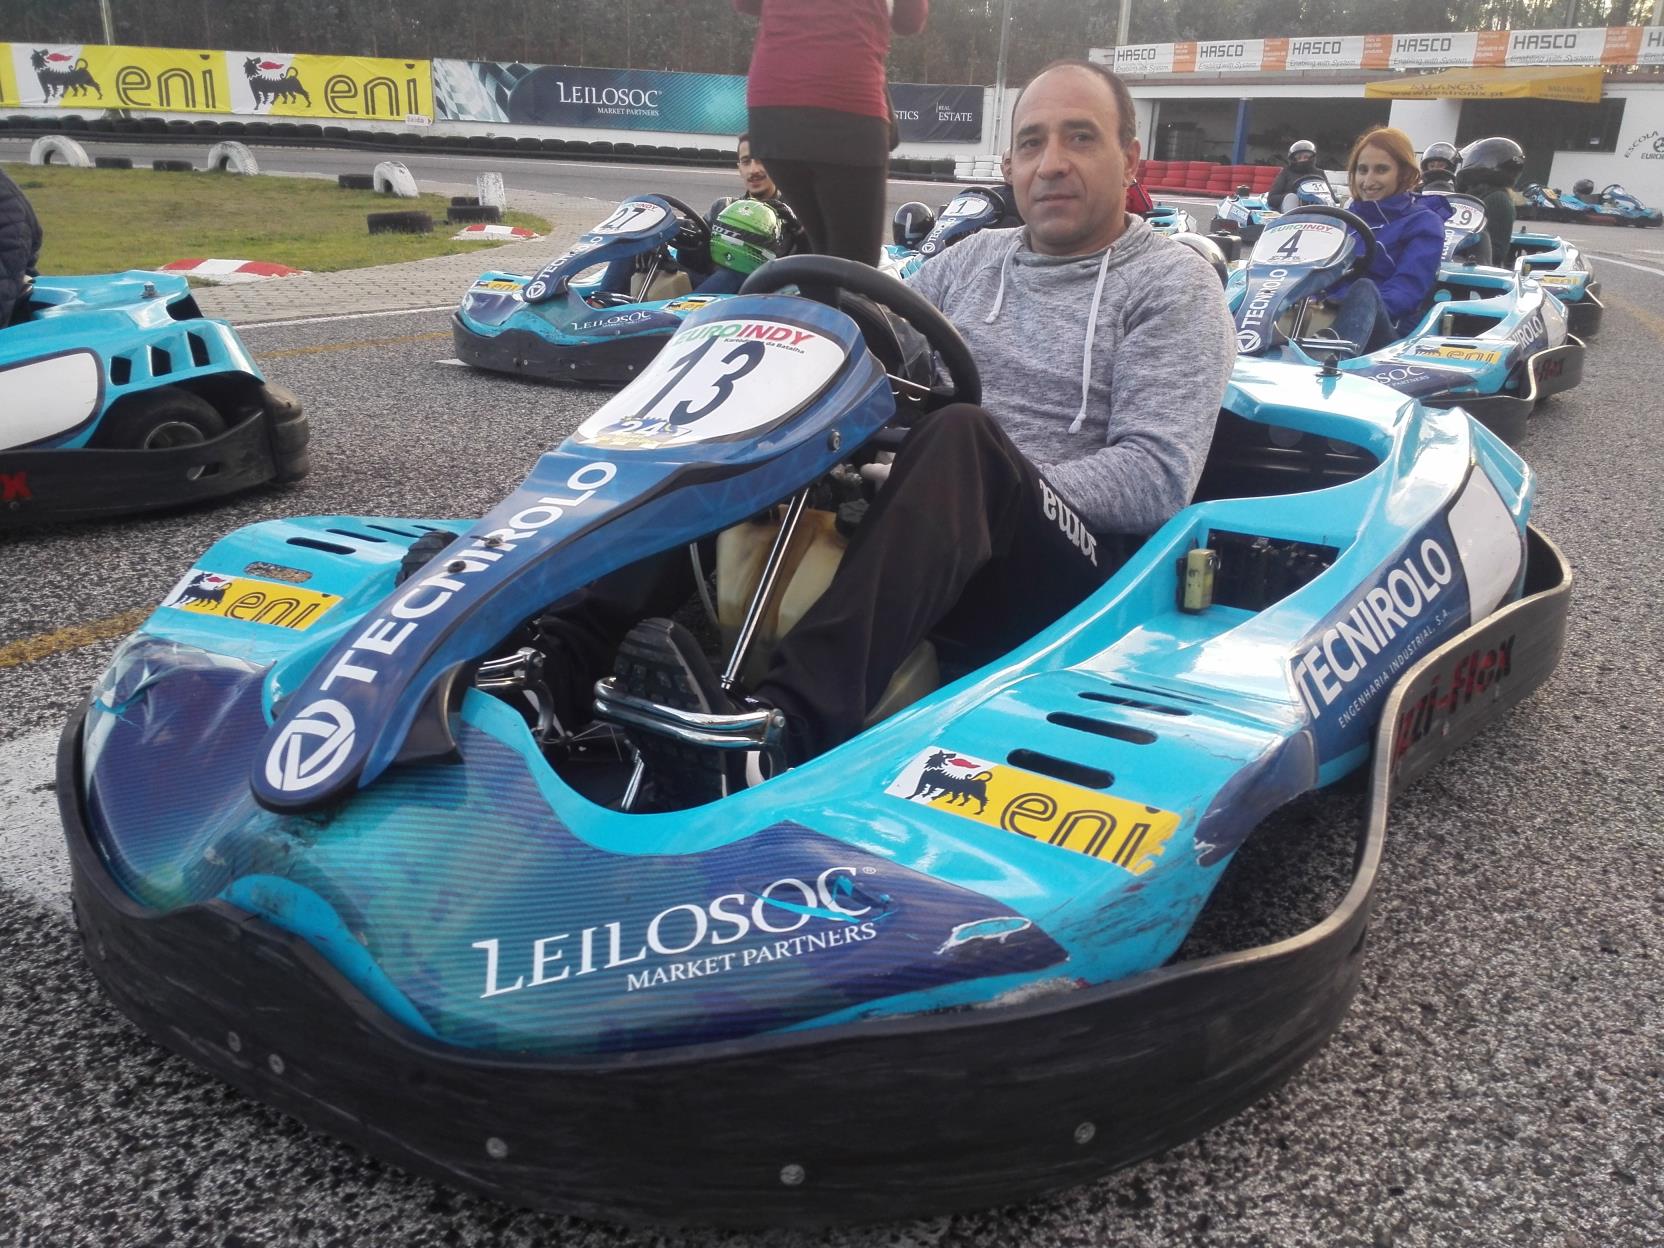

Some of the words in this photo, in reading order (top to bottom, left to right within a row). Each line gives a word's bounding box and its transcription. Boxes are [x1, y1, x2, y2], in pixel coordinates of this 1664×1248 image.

[1200, 44, 1244, 58] HASCO
[1292, 41, 1342, 55] HASCO
[1396, 38, 1452, 53] HASCO
[1512, 33, 1577, 50] HASCO
[1117, 48, 1156, 62] HASCO
[115, 54, 217, 109] eni
[323, 63, 419, 116] eni
[556, 81, 659, 107] LEILOSOC
[597, 107, 625, 115] MARKET
[626, 108, 660, 117] PARTNERS
[894, 111, 920, 120] STICS
[938, 112, 973, 122] ESTATE
[1311, 182, 1325, 192] 31
[601, 207, 646, 230] 27
[1270, 224, 1333, 234] EUROINDY
[1277, 229, 1303, 259] 4
[676, 323, 816, 348] EUROINDY
[776, 342, 805, 354] Batalha
[1446, 349, 1496, 364] eni
[634, 334, 766, 426] 13
[319, 461, 618, 692] TECNIROLO
[224, 592, 331, 629] eni
[1293, 538, 1453, 720] TECNIROLO
[1338, 671, 1390, 729] ENGENHARIA
[999, 792, 1162, 869] eni
[471, 866, 873, 999] LEILOSOC
[626, 953, 737, 992] MARKET
[742, 921, 878, 967] PARTNERS
